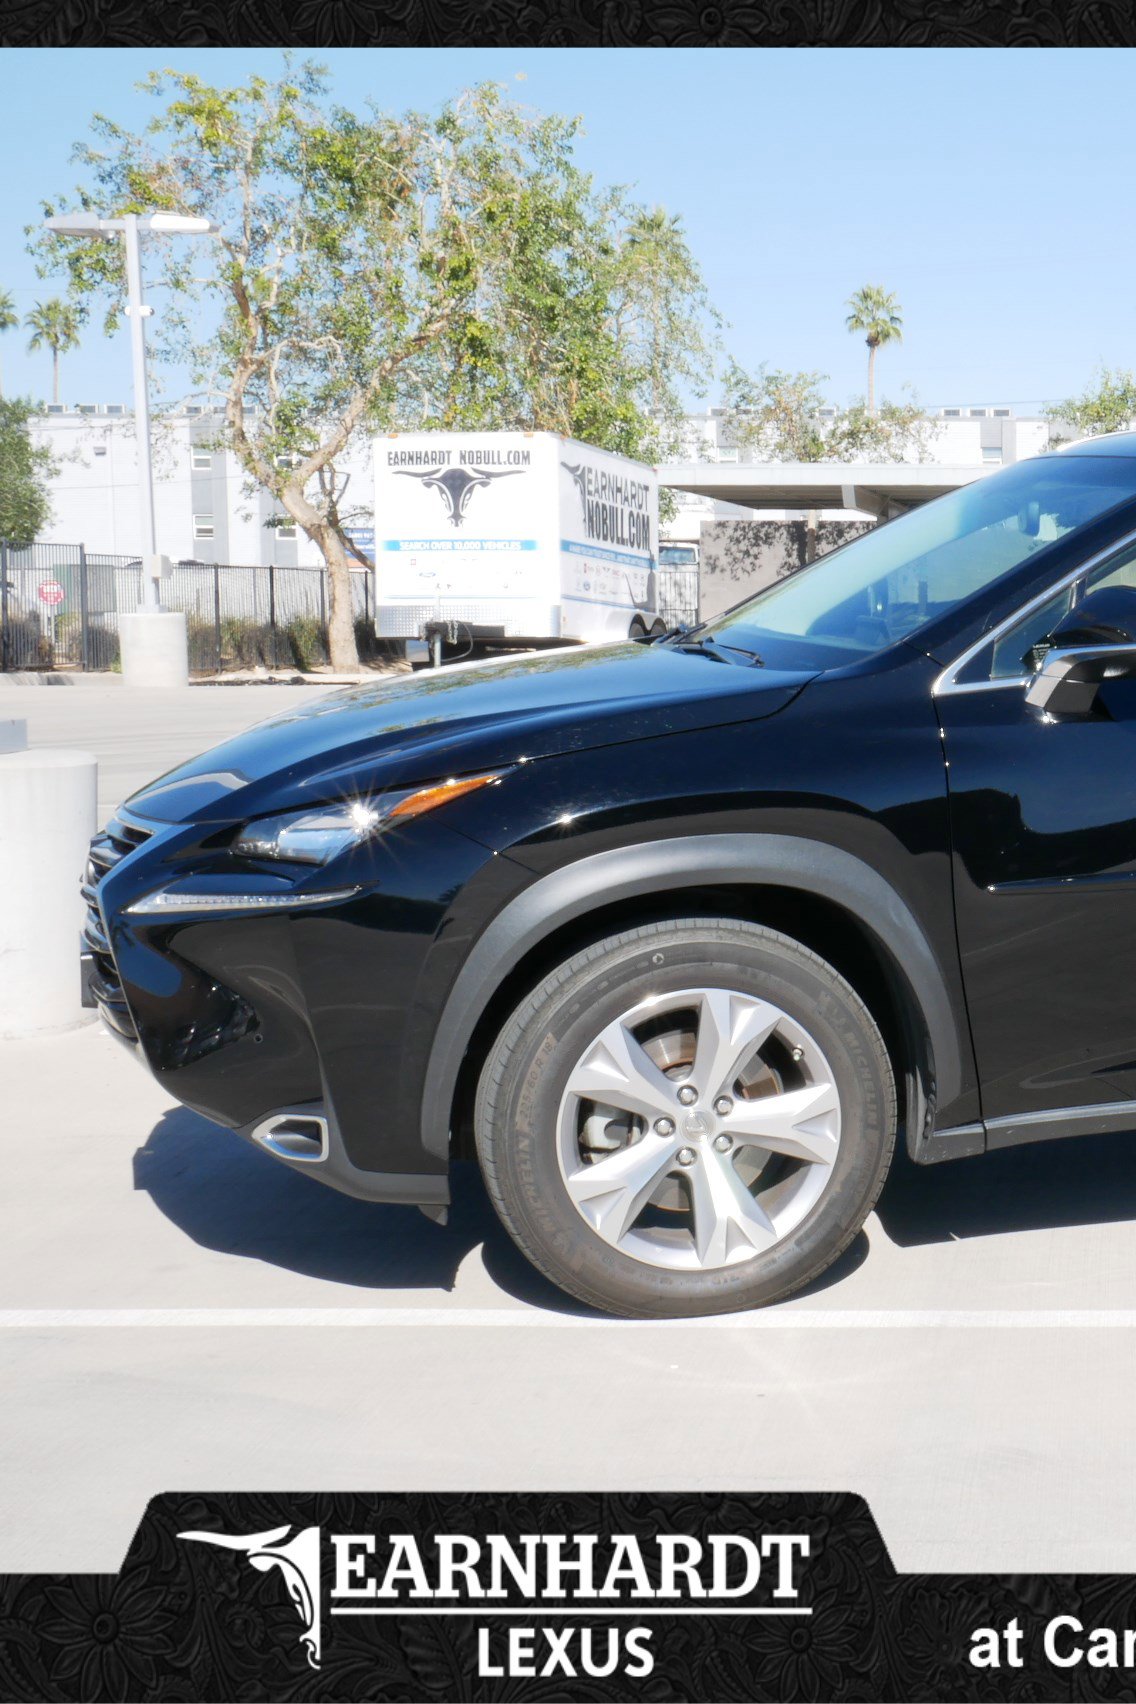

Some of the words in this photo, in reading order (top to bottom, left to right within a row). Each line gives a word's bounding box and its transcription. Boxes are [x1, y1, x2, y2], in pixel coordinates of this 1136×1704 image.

[387, 450, 451, 466] EARNHARDT
[460, 449, 531, 466] NOBULL.COM
[586, 466, 650, 512] EARNHARDT
[399, 540, 430, 550] SEARCH
[431, 540, 453, 550] OVER
[482, 540, 522, 550] VEHICLES
[587, 499, 651, 551] NOBULL.COM
[519, 1070, 539, 1120] 225/60
[841, 1031, 878, 1130] MICHELIN
[516, 1132, 557, 1233] MICHELIN
